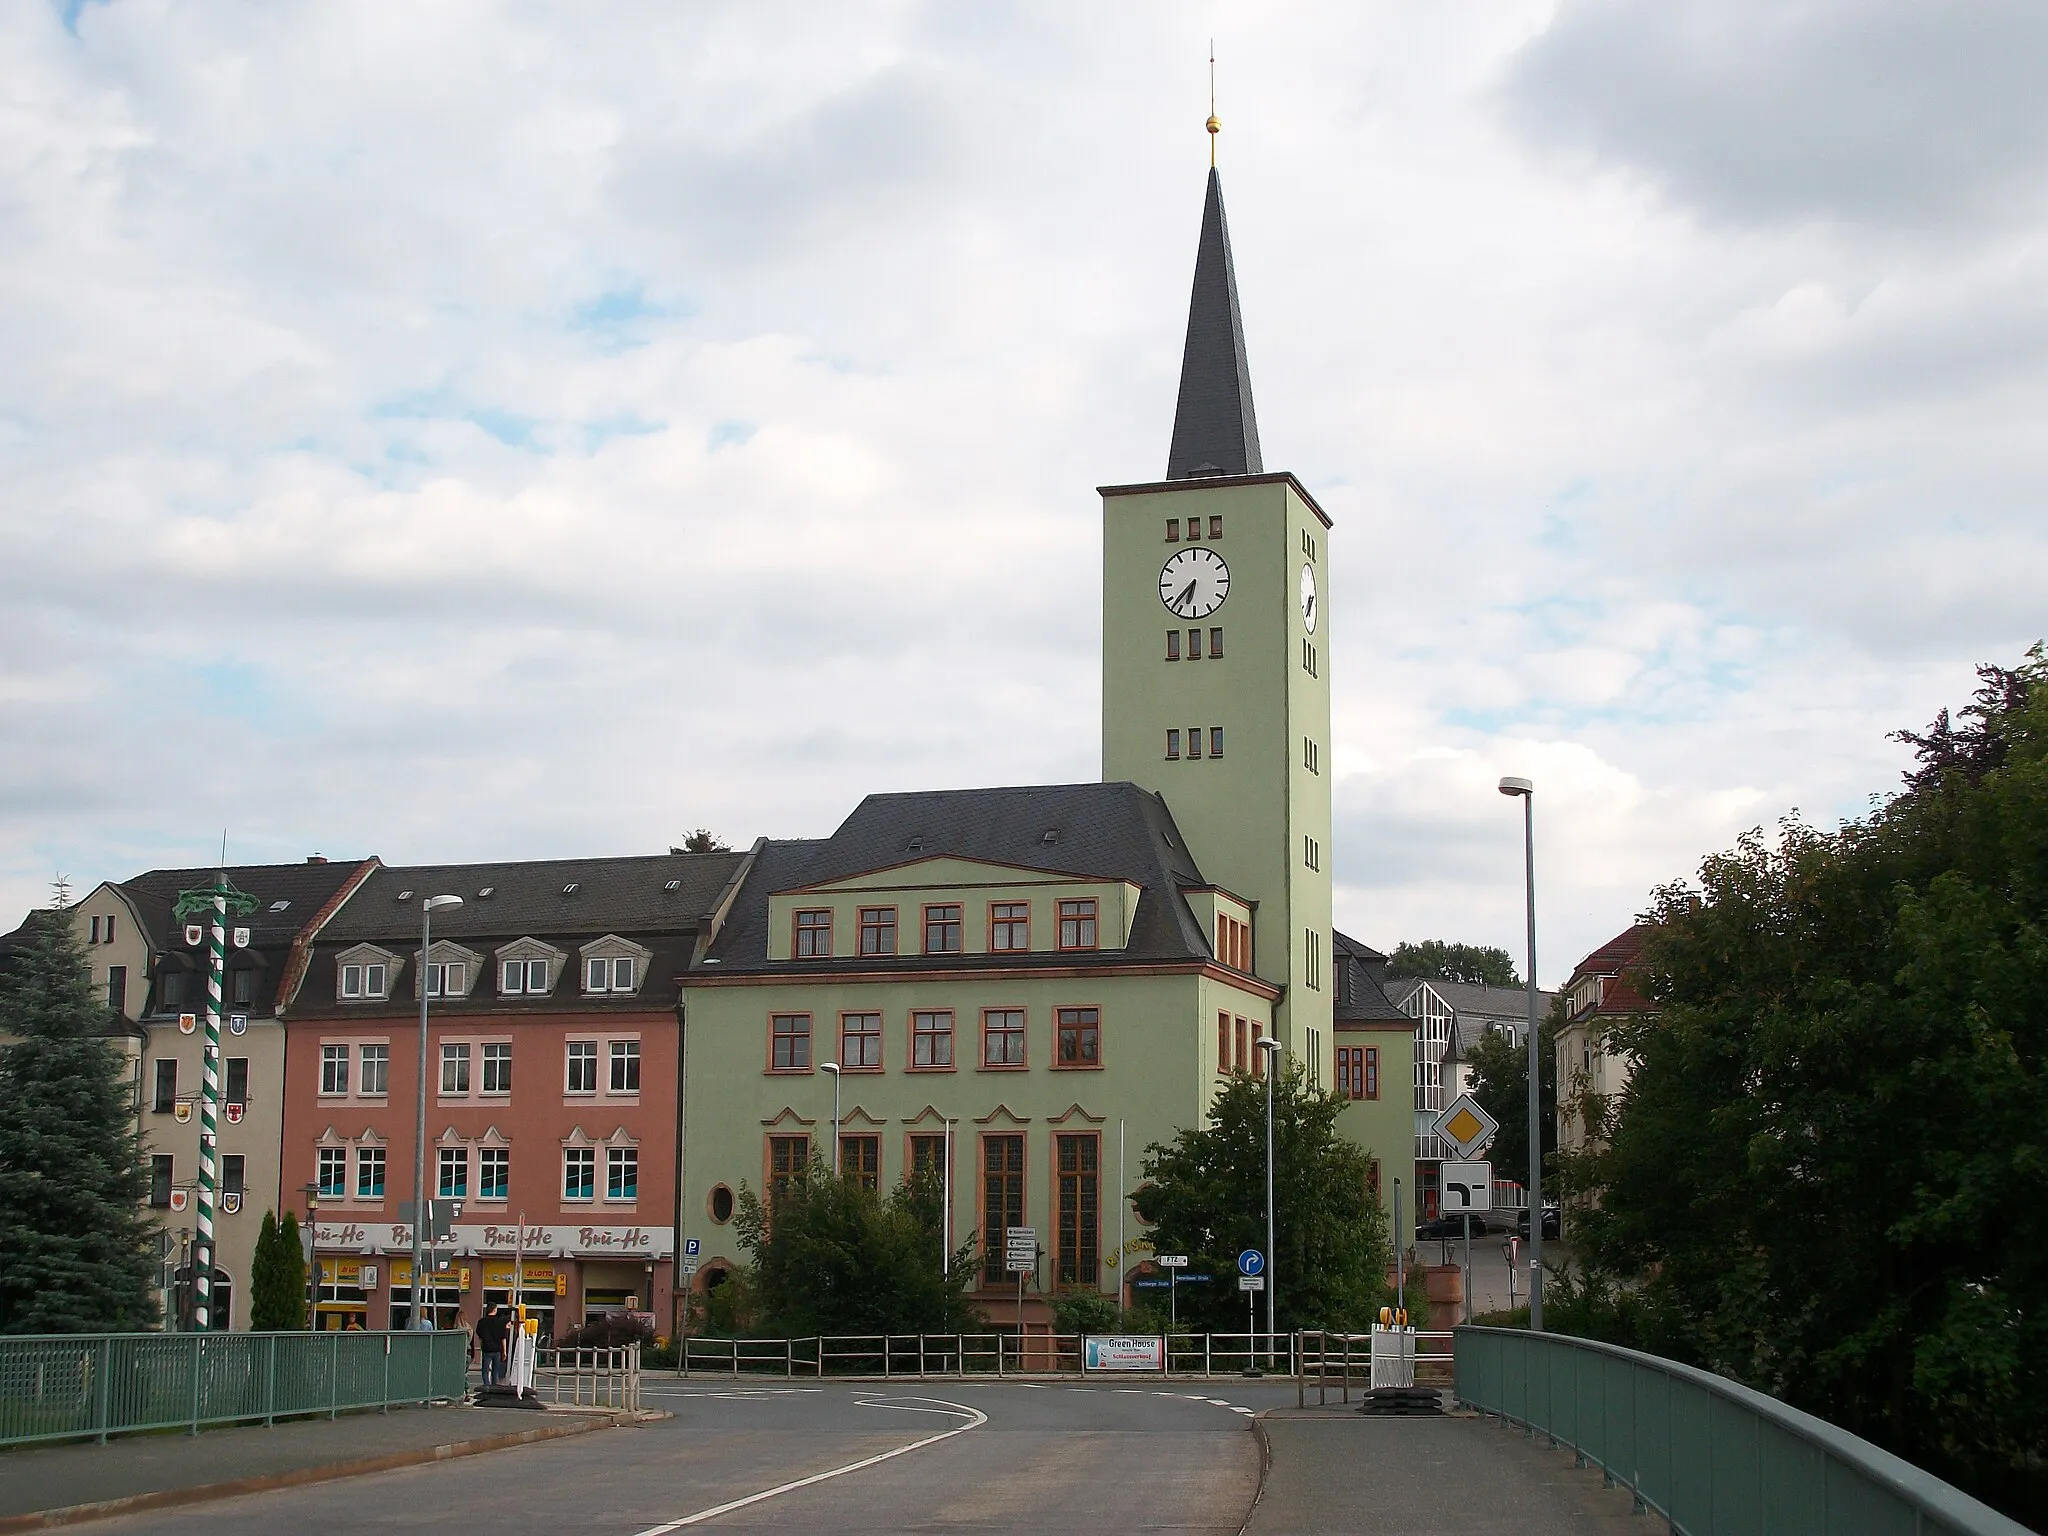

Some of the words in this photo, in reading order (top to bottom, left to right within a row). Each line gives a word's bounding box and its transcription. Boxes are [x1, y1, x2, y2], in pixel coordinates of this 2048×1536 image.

[314, 1224, 365, 1244] rü-He
[392, 1225, 458, 1245] Bre
[578, 1227, 650, 1250] Brü-He
[688, 1240, 697, 1253] P
[1109, 1339, 1131, 1347] Green
[1132, 1339, 1155, 1347] House
